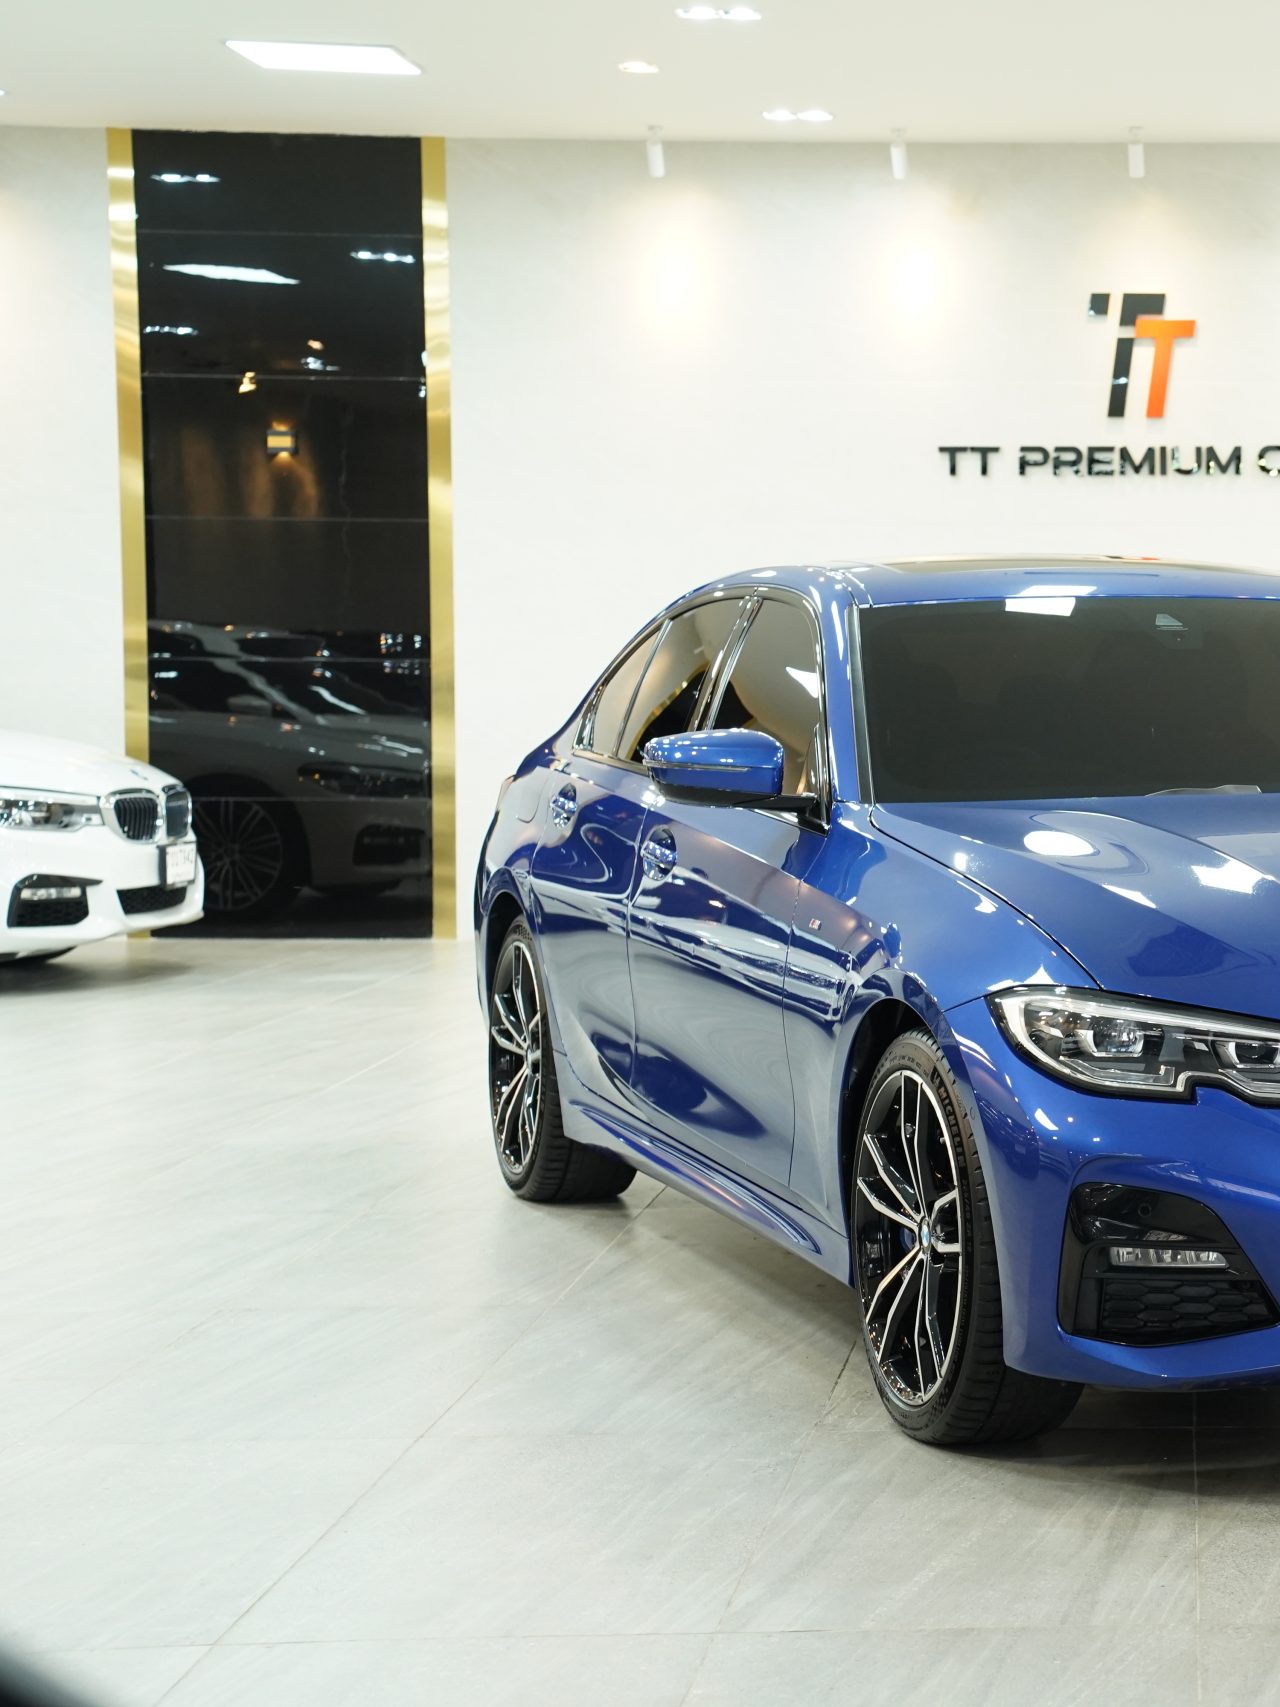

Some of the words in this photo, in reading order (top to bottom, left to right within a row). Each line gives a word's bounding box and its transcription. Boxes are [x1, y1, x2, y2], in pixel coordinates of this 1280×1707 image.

[938, 446, 1000, 476] TT
[1018, 446, 1243, 476] PREMIUM
[938, 1086, 966, 1168] MICHELIN
